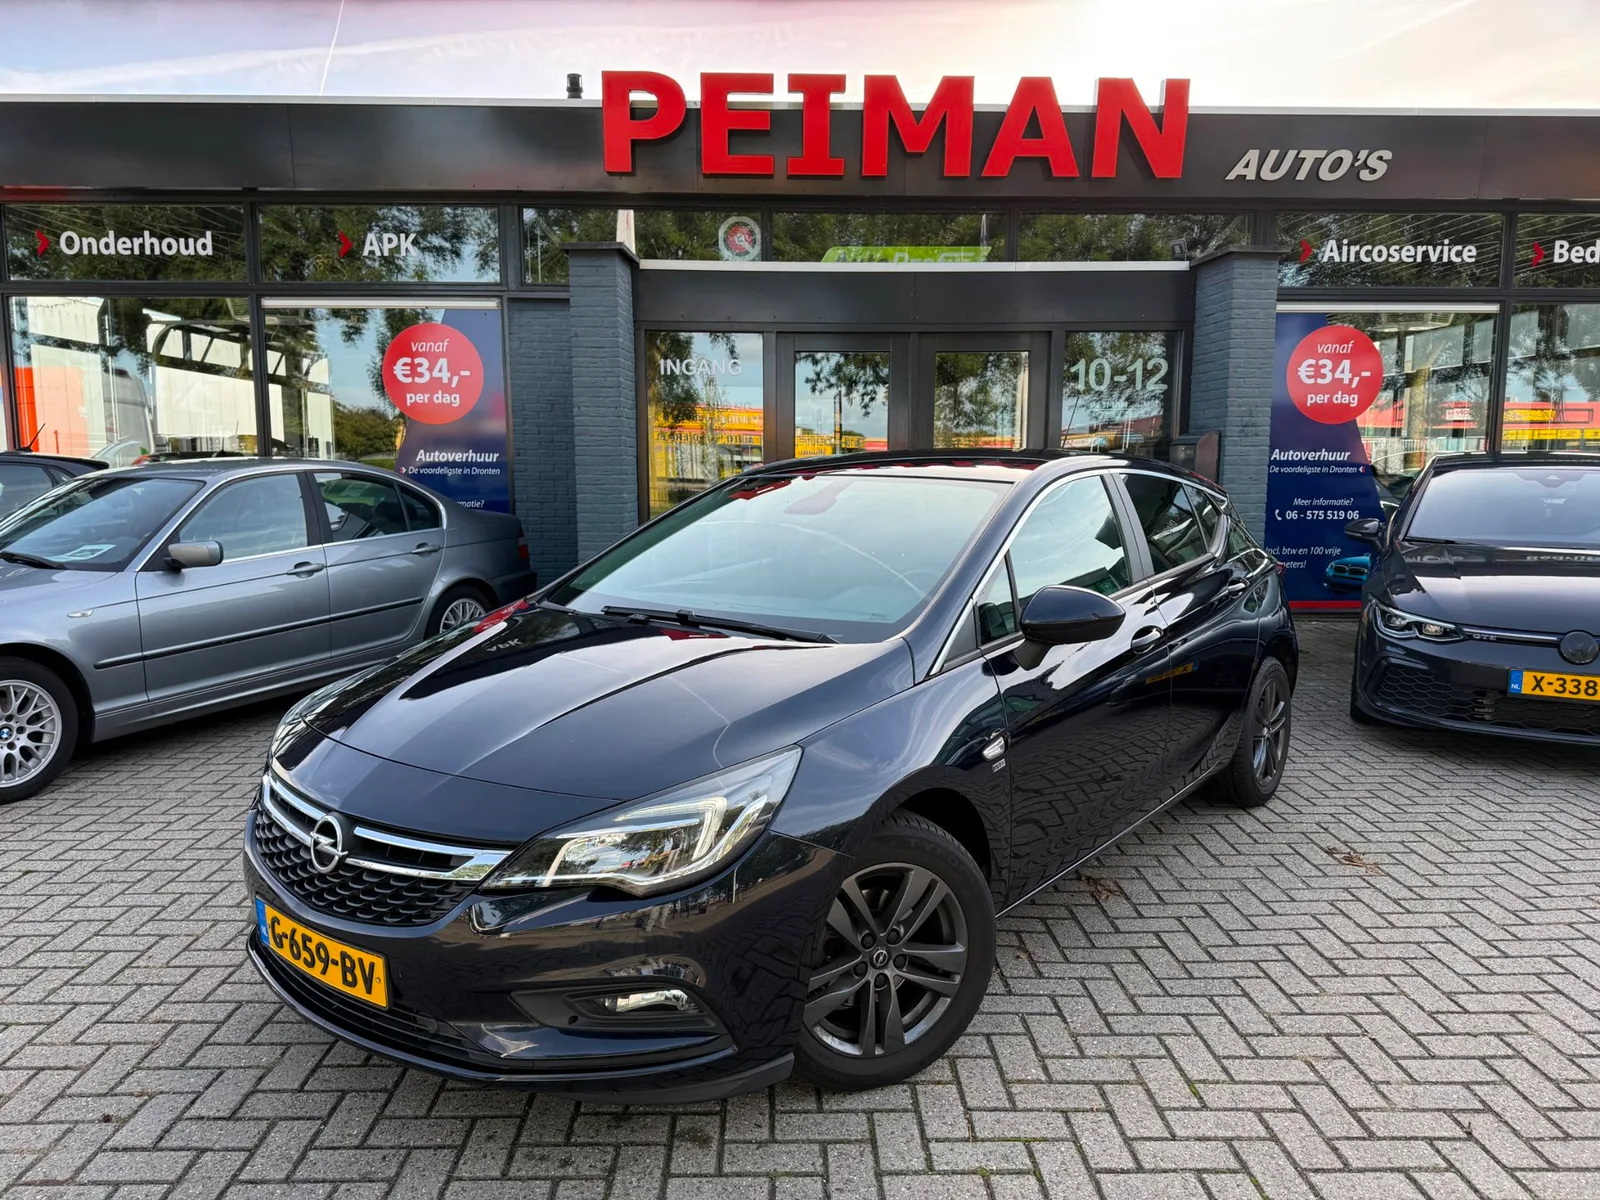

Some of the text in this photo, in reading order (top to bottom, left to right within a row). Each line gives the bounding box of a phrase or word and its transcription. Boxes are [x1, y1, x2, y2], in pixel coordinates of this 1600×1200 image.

[601, 70, 1191, 179] PEIMAN
[1225, 148, 1393, 182] AUTO'S
[59, 230, 213, 256] Onderhoud
[362, 232, 417, 257] APK
[1321, 238, 1477, 263] Aircoservice
[410, 338, 450, 352] vanaf
[1317, 340, 1355, 354] vanaf
[393, 356, 471, 388] €34,-
[659, 358, 743, 376] INGANG
[1069, 357, 1169, 391] 10-12
[1297, 358, 1372, 389] €34,-
[406, 389, 460, 407] per dag
[1306, 390, 1359, 408] per dag
[416, 449, 499, 463] Autoverhuur
[1270, 448, 1351, 461] Autoverhuur
[408, 466, 501, 476] De voordeligste in Dronten
[1269, 465, 1358, 475] De voordeligste in Dronten
[457, 500, 485, 509] matie?
[1292, 498, 1354, 506] Meer informatie?
[1285, 510, 1298, 520] 06
[1306, 510, 1325, 520] 575
[1326, 510, 1345, 520] 519
[1346, 510, 1360, 520] 06
[1282, 547, 1297, 555] btw
[1310, 547, 1324, 555] 100
[1325, 547, 1342, 556] vrije
[1282, 560, 1307, 569] eters!
[1472, 633, 1497, 641] GTE
[1531, 674, 1599, 697] X-338
[269, 916, 375, 995] G-659-BV
